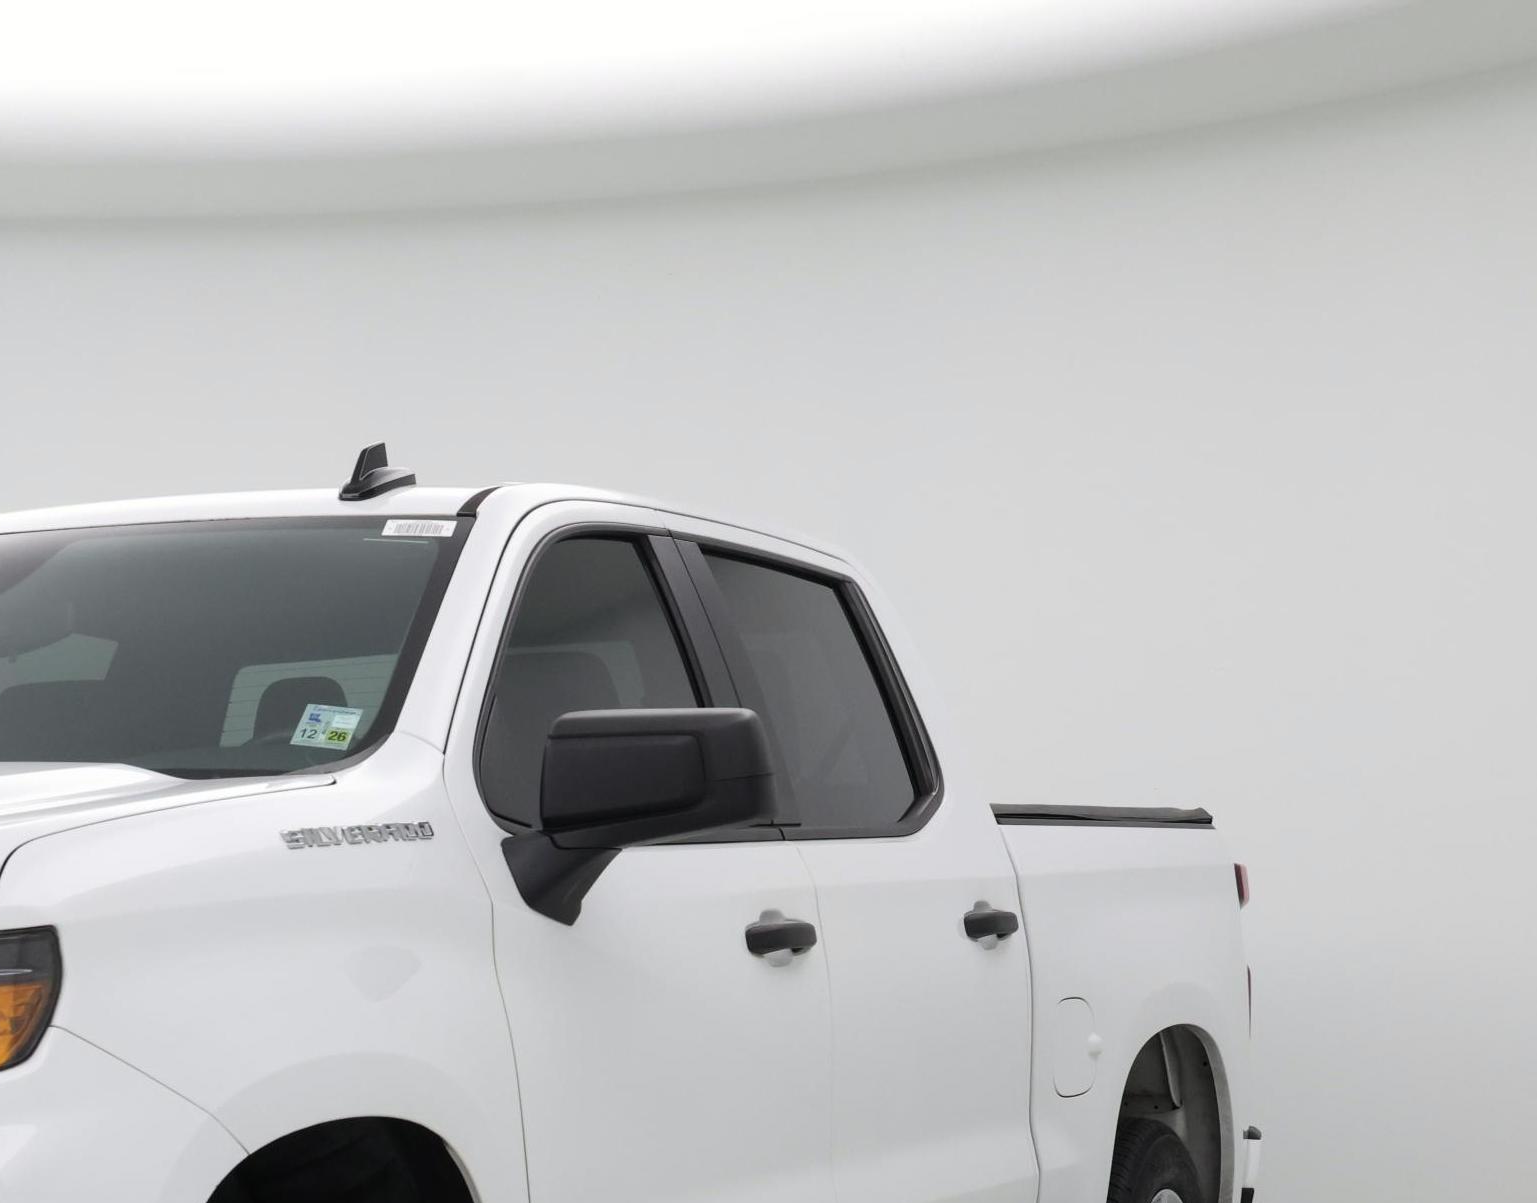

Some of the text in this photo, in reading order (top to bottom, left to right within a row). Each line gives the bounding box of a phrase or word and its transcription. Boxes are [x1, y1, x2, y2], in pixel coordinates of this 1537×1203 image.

[300, 728, 318, 740] 12
[328, 731, 348, 742] 26
[280, 822, 434, 849] SILVERADO
